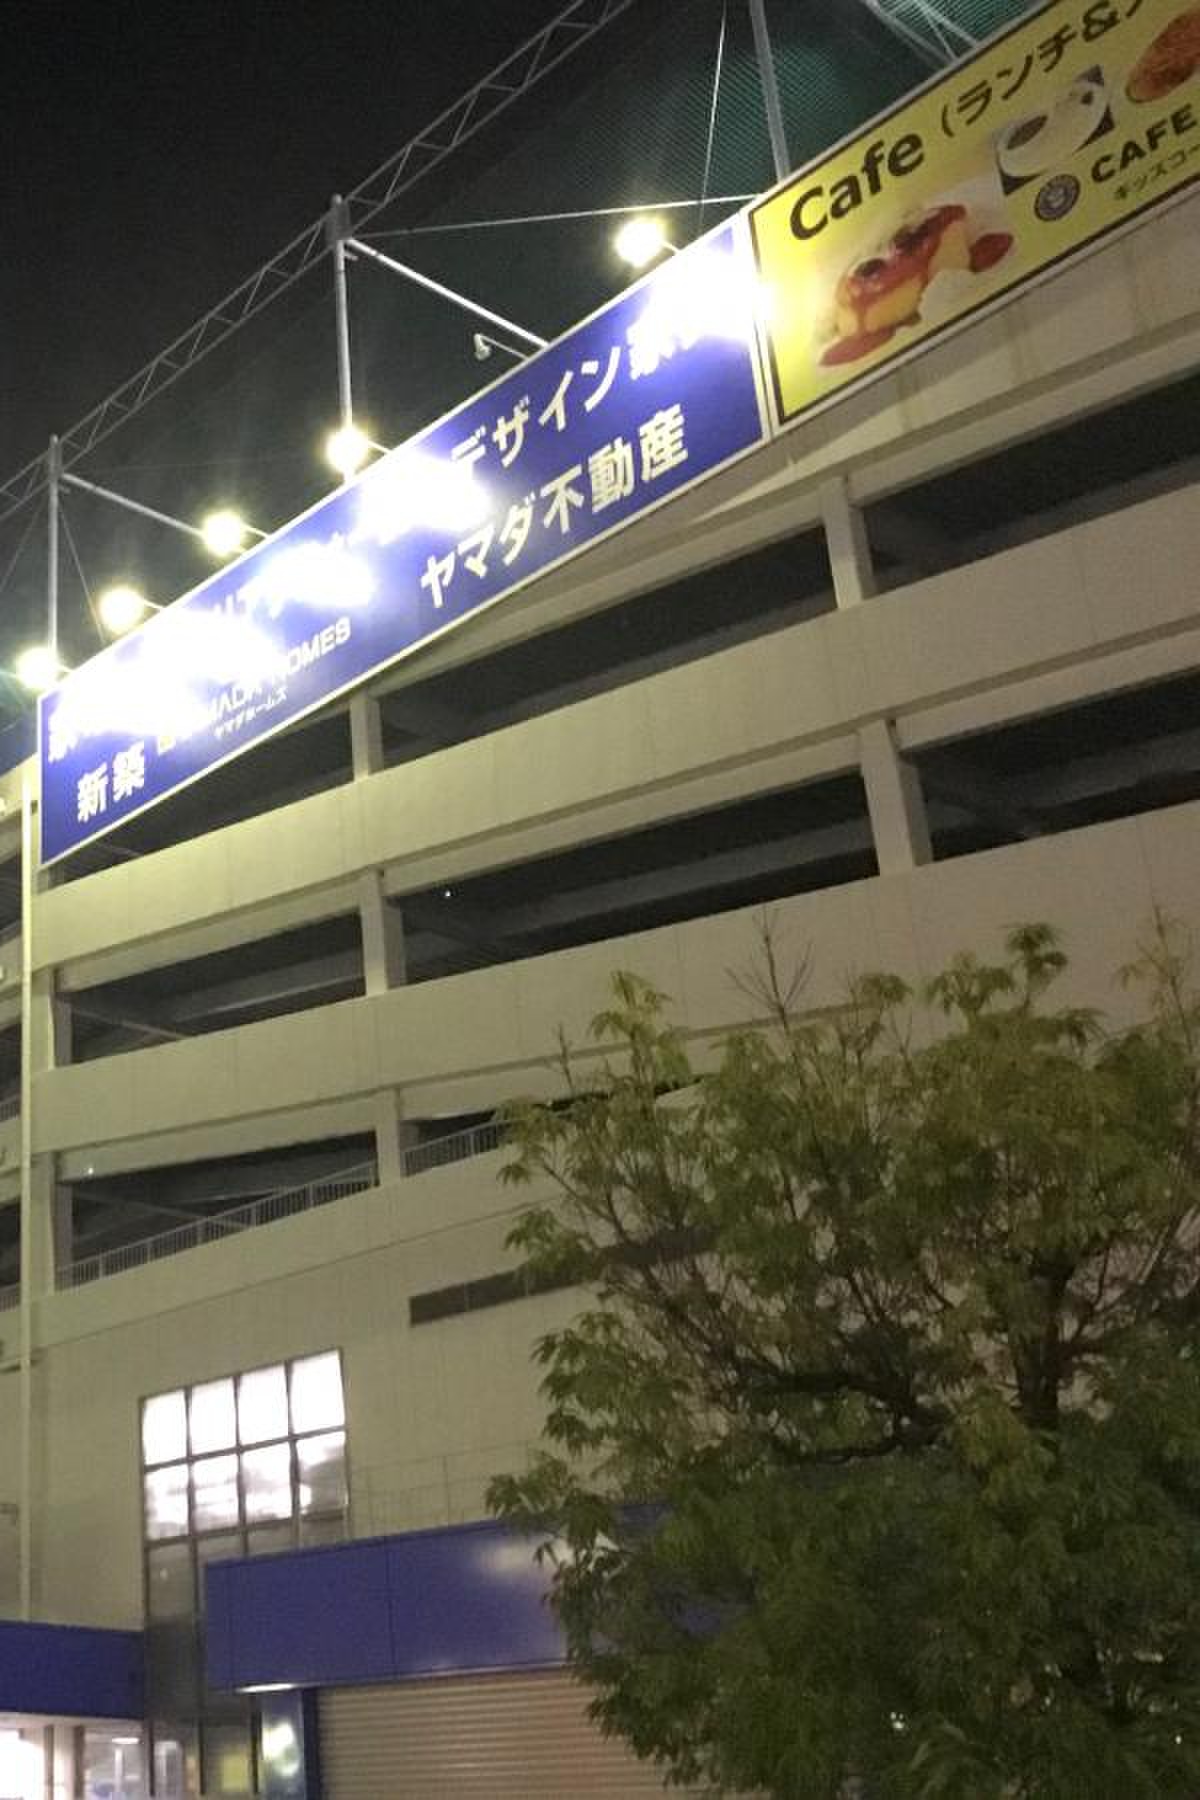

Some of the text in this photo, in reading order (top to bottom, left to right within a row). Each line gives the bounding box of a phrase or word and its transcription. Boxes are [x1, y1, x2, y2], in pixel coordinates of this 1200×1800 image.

[789, 132, 925, 240] Cafe
[1090, 103, 1198, 183] CAFE
[420, 403, 688, 607] ヤマダ不動産
[77, 740, 145, 822] 新築
